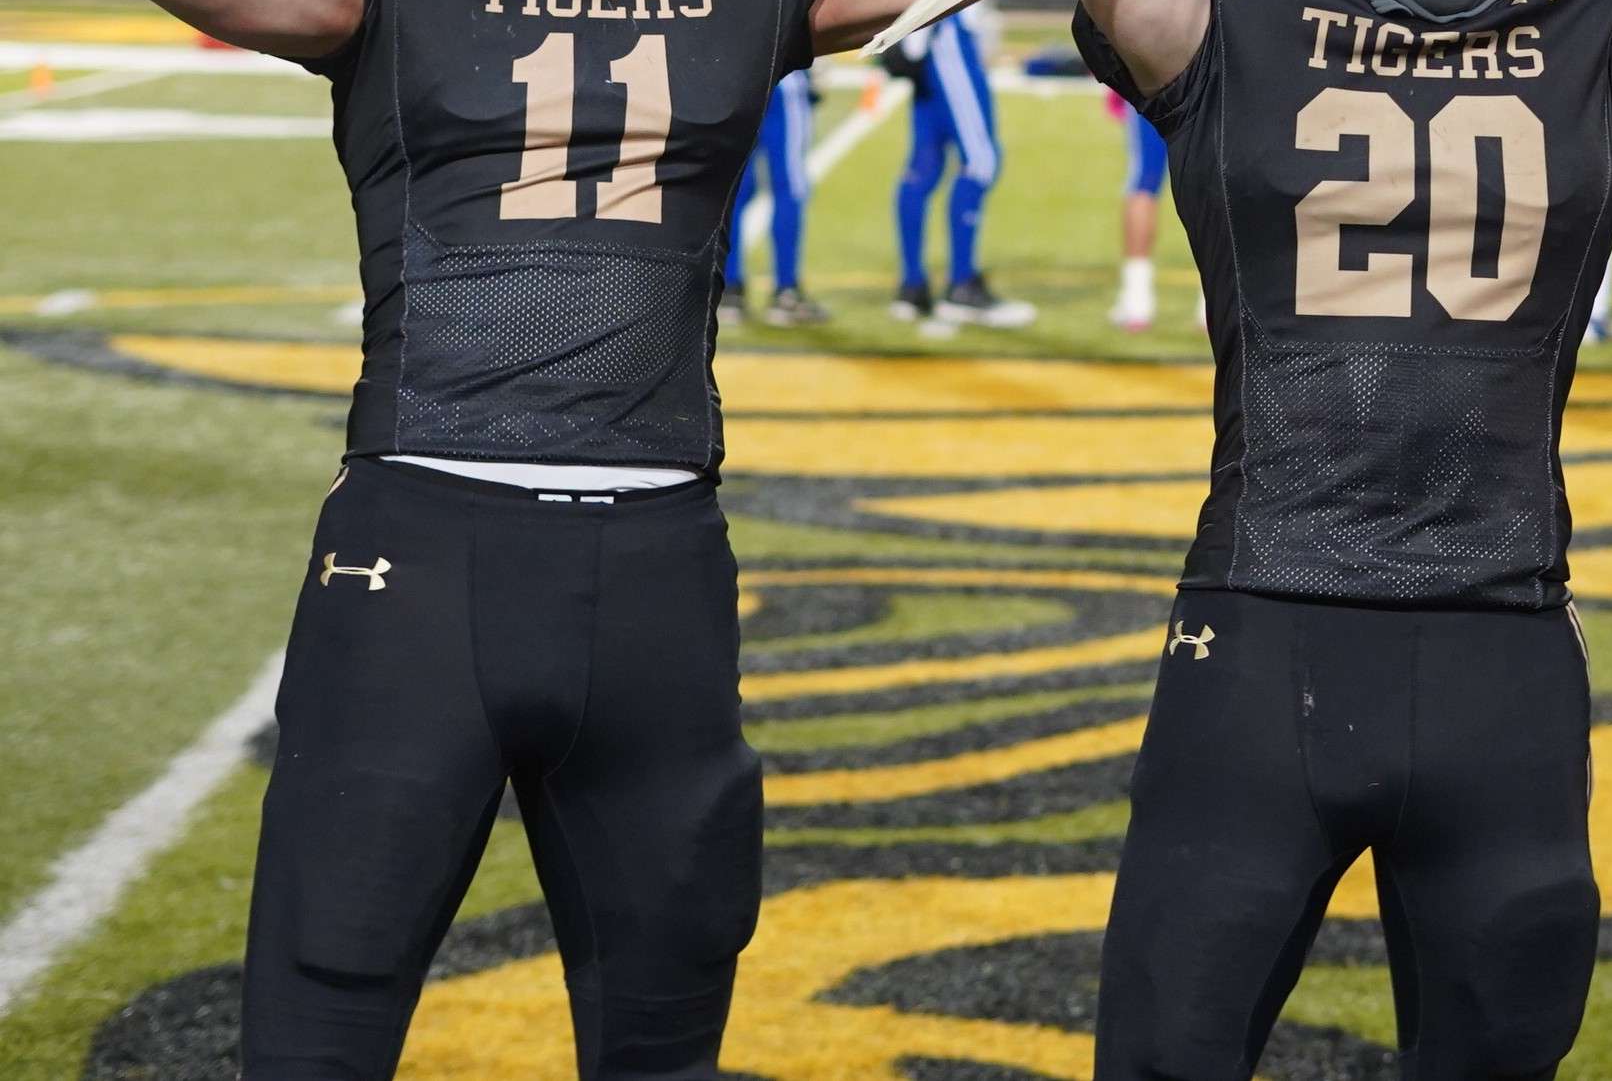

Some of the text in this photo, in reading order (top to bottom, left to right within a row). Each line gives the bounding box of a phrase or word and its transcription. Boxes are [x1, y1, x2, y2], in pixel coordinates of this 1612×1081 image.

[500, 32, 672, 224] 11
[1302, 7, 1545, 79] TIGERS
[1295, 87, 1549, 322] 20
